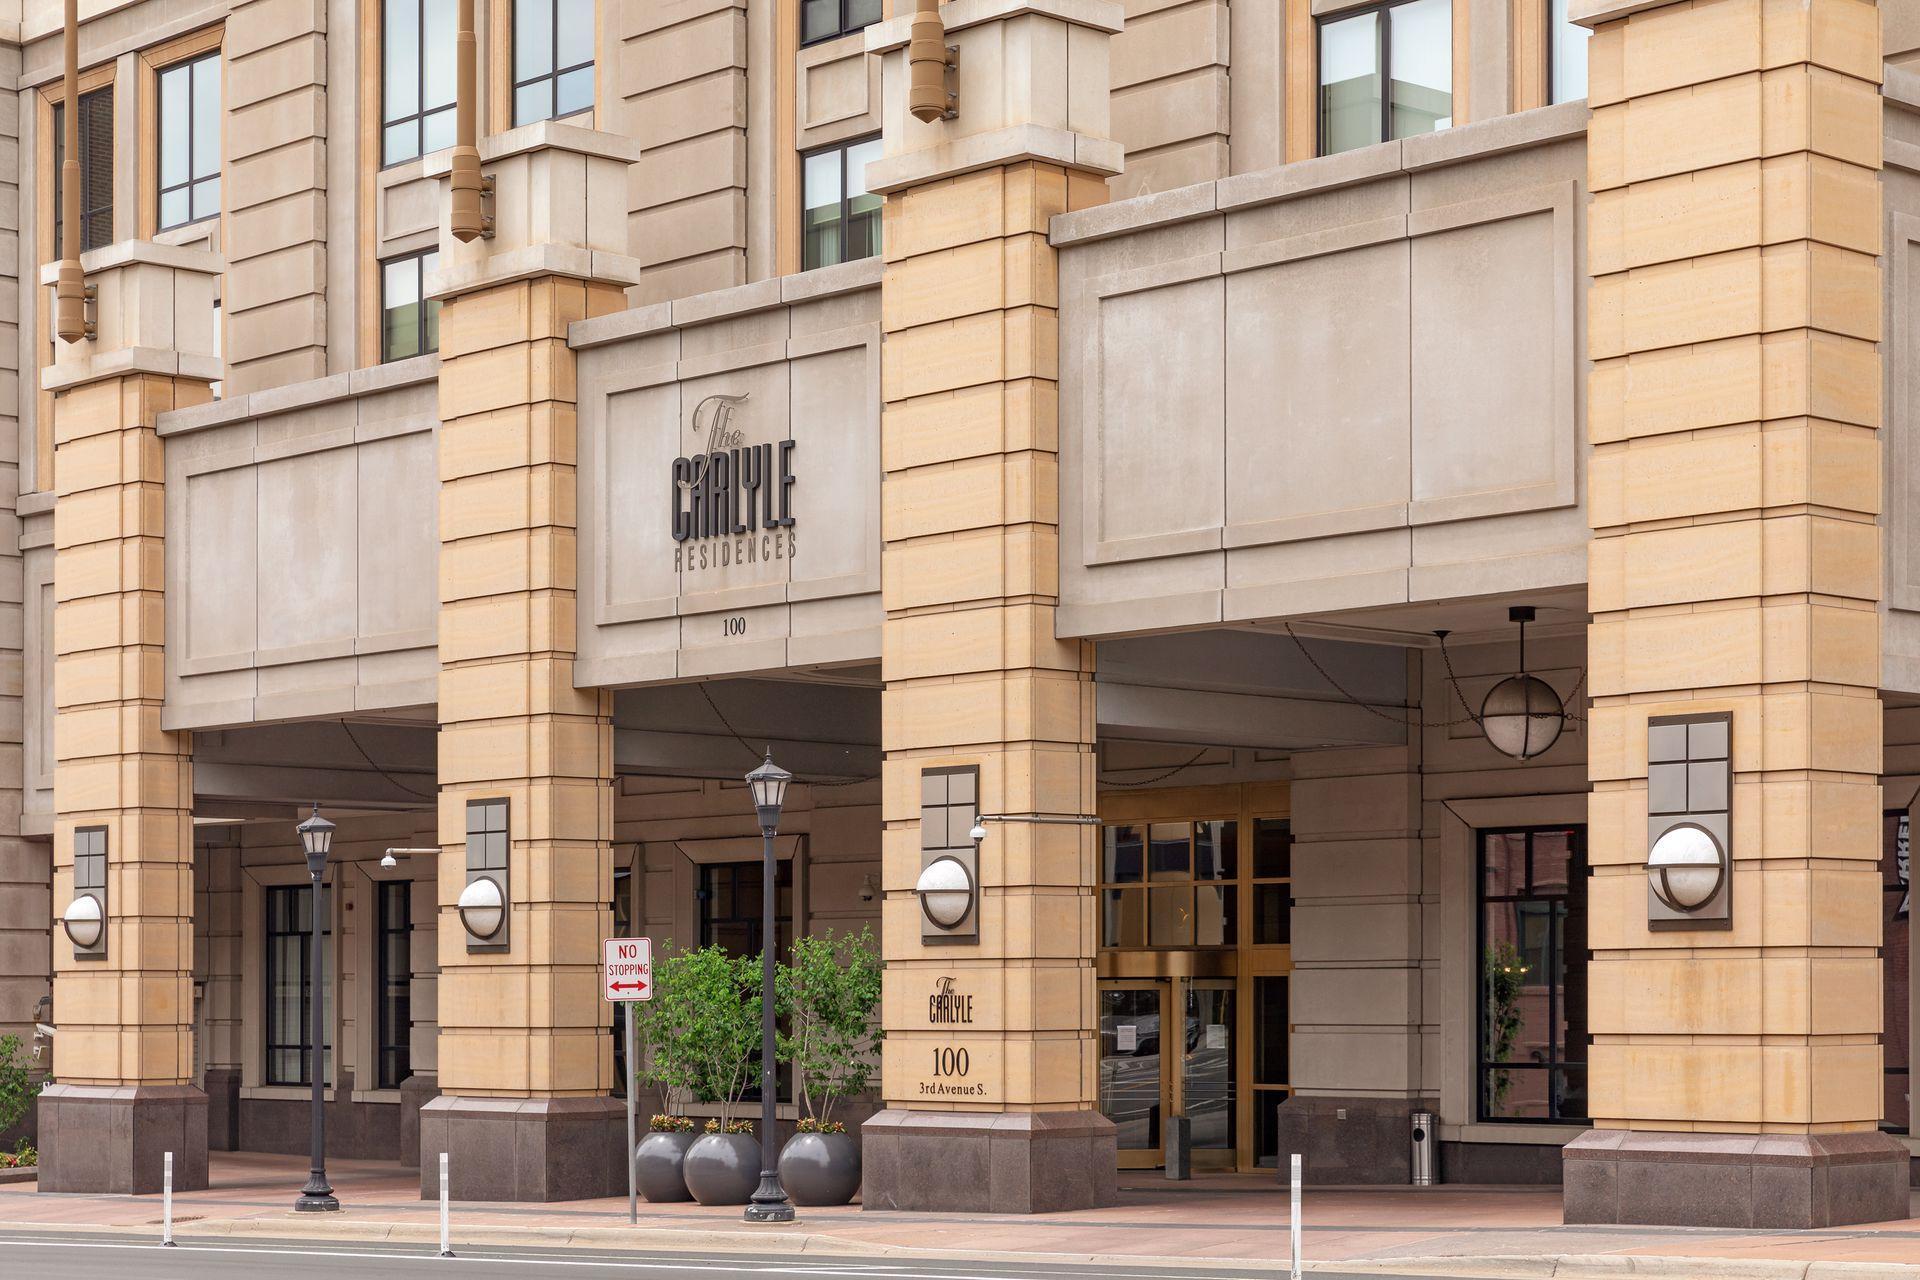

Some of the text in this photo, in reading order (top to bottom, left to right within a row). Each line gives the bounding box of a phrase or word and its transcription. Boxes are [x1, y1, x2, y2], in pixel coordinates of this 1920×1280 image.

[677, 391, 750, 490] The
[671, 439, 796, 542] CARLYLE
[674, 531, 797, 573] RESIDENCES
[723, 616, 746, 637] 100
[618, 944, 637, 959] NO
[608, 963, 649, 976] STOPPING
[929, 994, 973, 1024] CARLYLE
[932, 1047, 969, 1077] 100
[919, 1082, 987, 1096] 3rd Avenue S.
